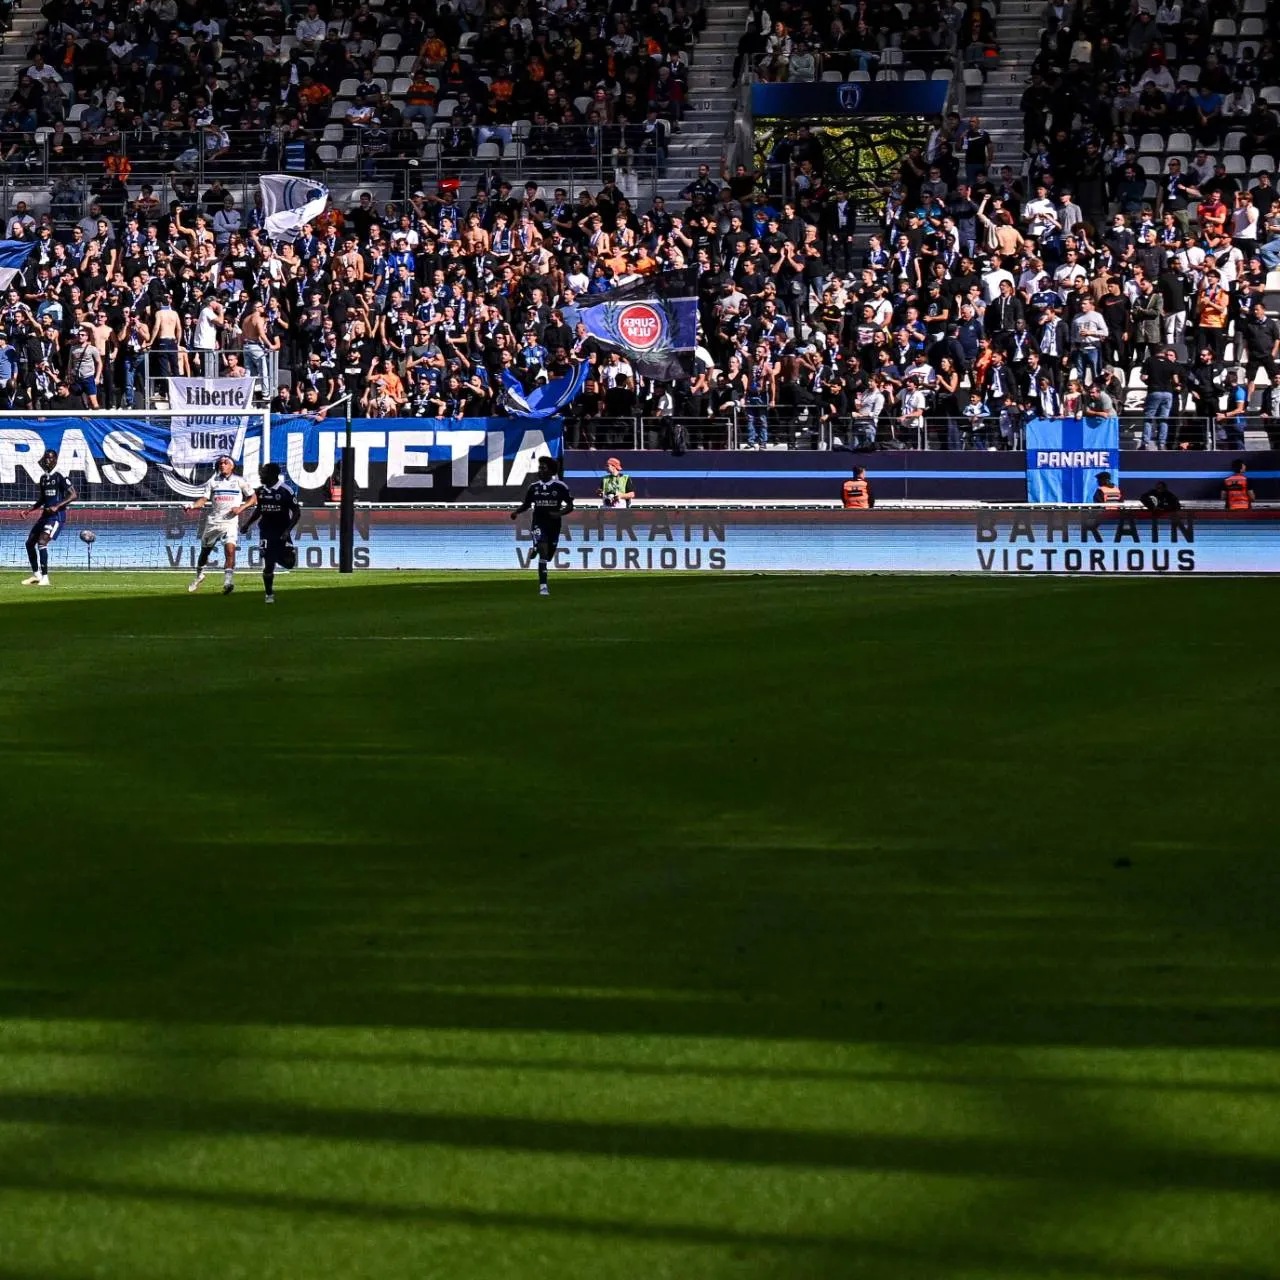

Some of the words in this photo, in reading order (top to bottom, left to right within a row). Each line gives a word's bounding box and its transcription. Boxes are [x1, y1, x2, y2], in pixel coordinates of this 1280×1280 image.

[186, 386, 244, 406] Liberté
[190, 431, 235, 450] Ultras
[1036, 451, 1110, 468] PANAME
[976, 511, 1195, 543] BAHRAIN
[976, 549, 1195, 571] VICTORIOUS
